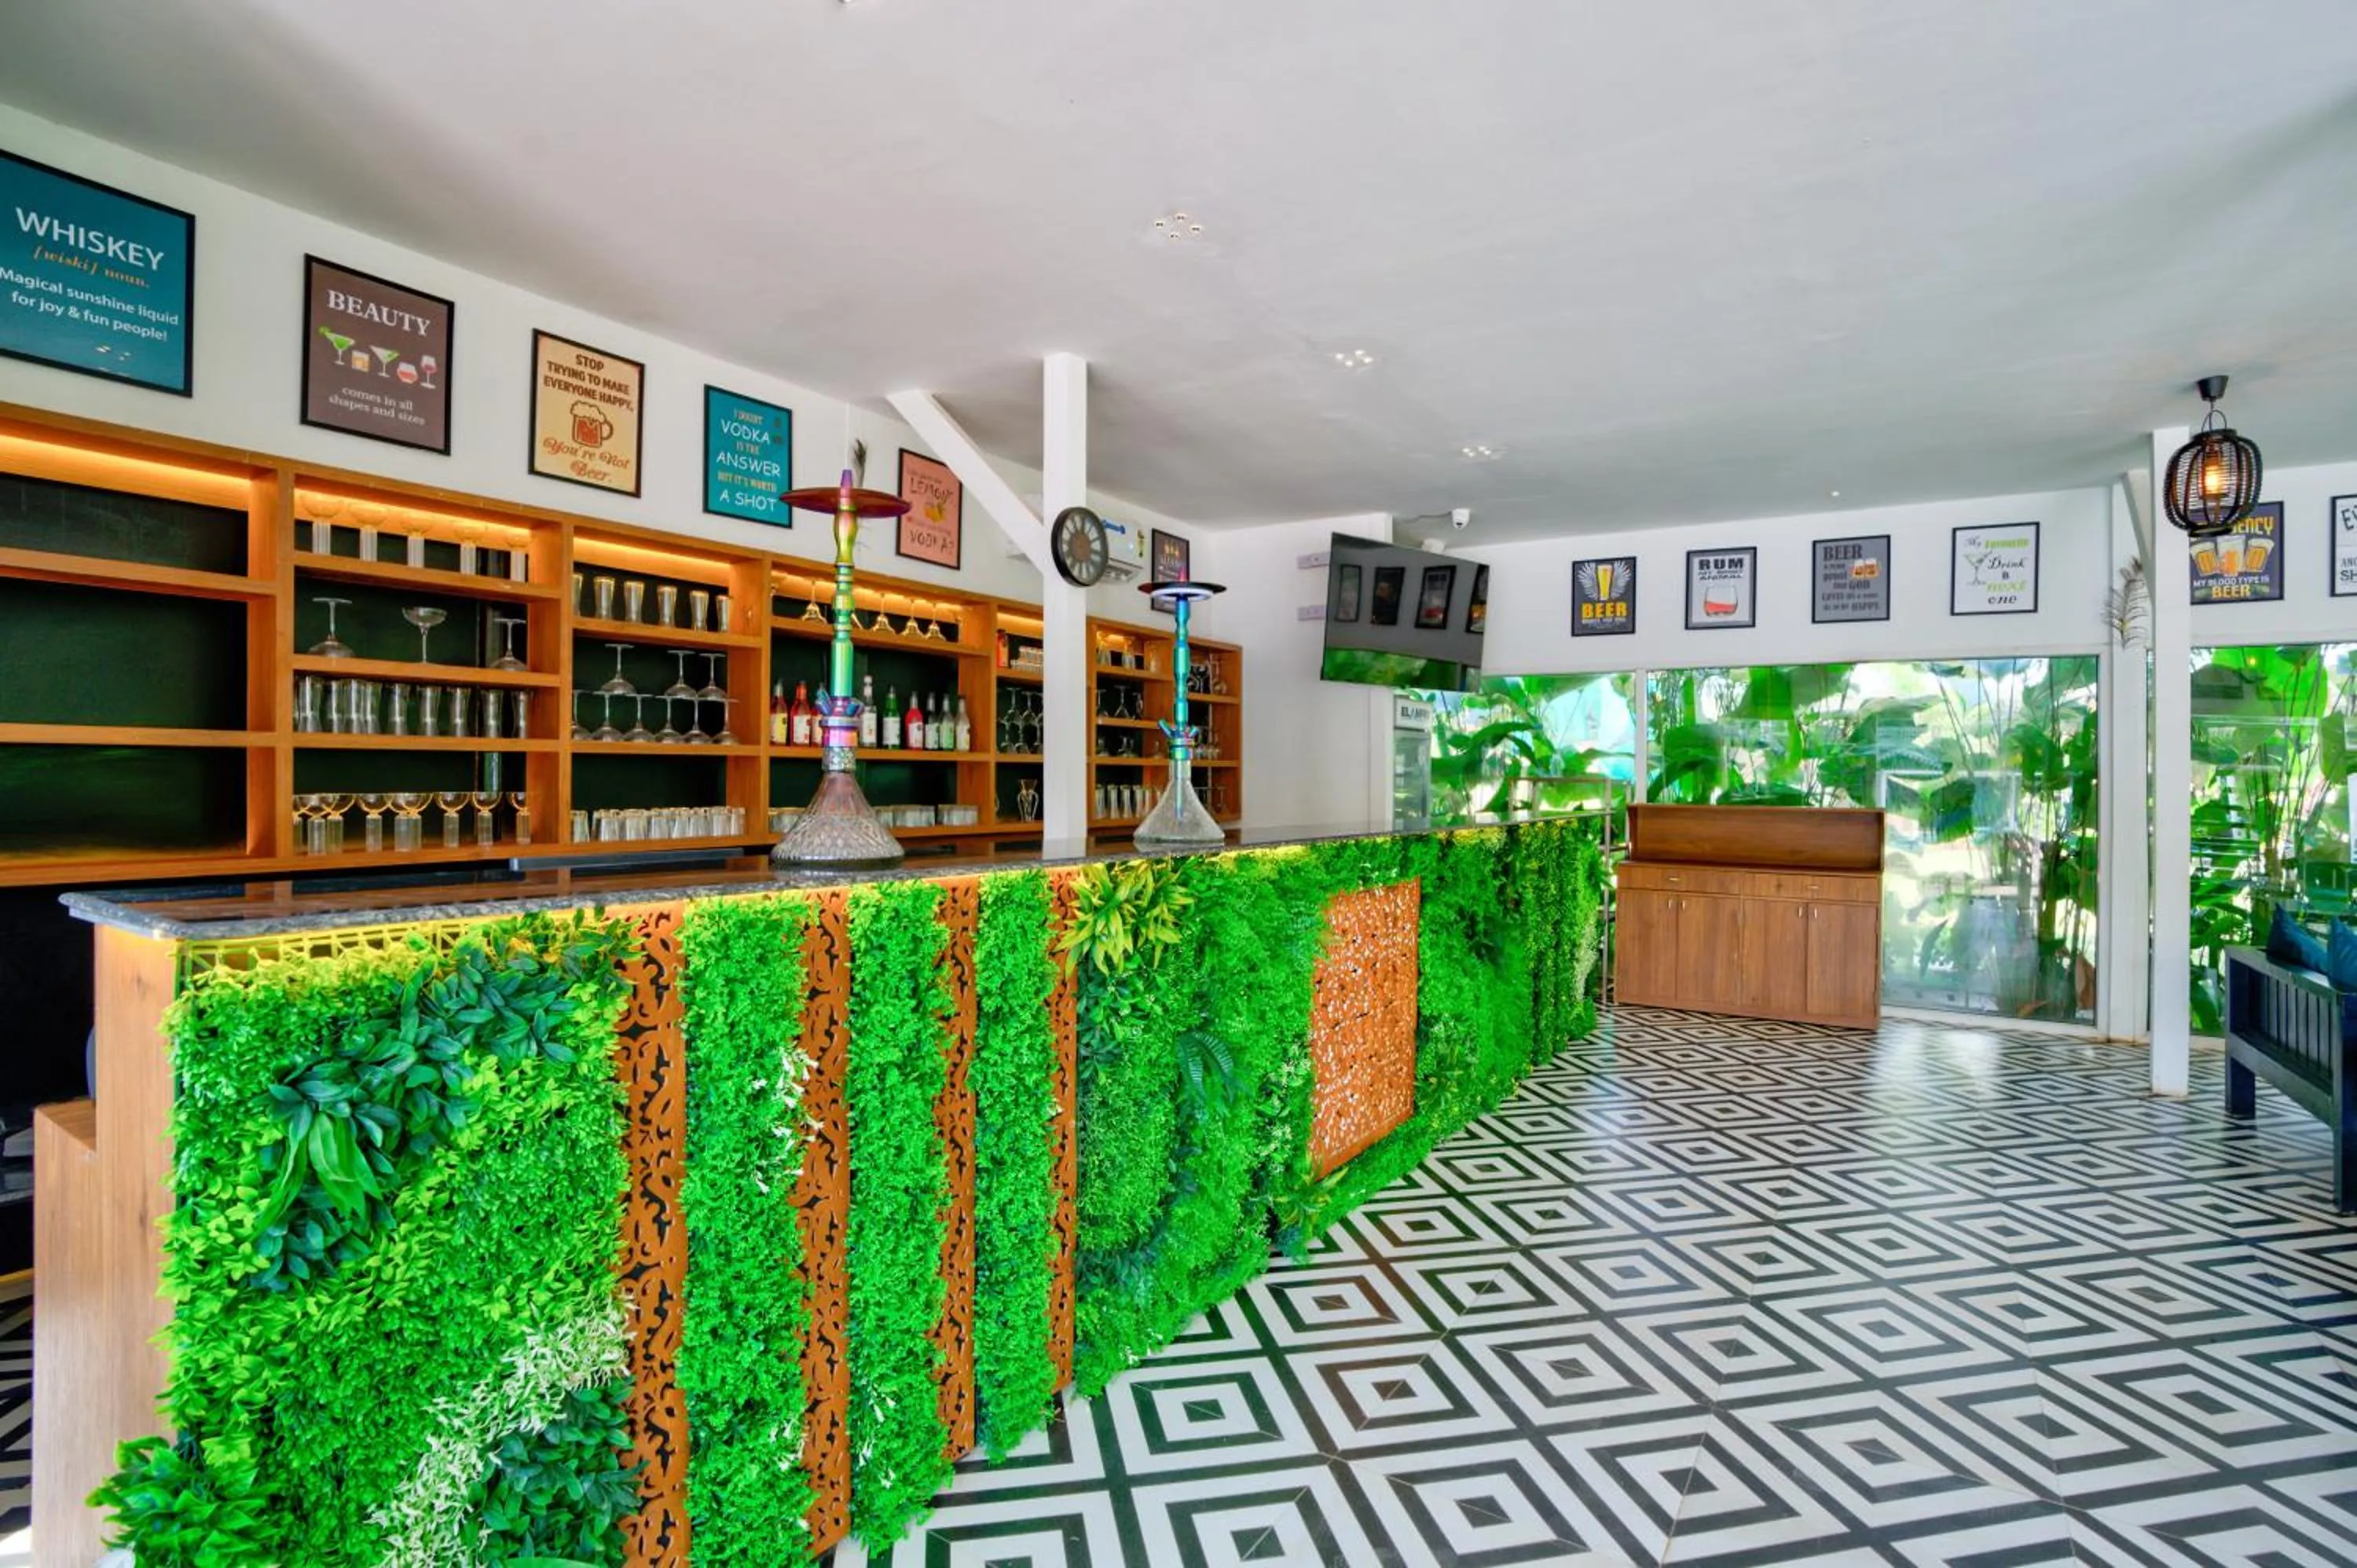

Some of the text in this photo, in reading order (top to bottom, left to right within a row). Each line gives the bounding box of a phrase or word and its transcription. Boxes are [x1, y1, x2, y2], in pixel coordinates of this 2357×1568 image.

[16, 207, 164, 271] WHISKEY
[0, 267, 178, 325] Magical sunshine liquid
[12, 291, 167, 341] for joy & fun people!
[328, 289, 431, 337] BEAUTY
[576, 354, 604, 372] STOP
[544, 376, 598, 400] EVERYONE
[547, 361, 629, 395] TRYING TO MAKE
[328, 395, 426, 426] shapes and sizes
[342, 387, 412, 412] comes in all
[720, 418, 771, 445] VODKA
[716, 452, 781, 478] ANSWER
[719, 489, 777, 512] A SHOT
[1699, 557, 1744, 570] RUM
[1823, 544, 1863, 561] BEER
[1987, 554, 2029, 570] Drink
[2212, 584, 2251, 598] BEER
[1582, 602, 1627, 618] BEER
